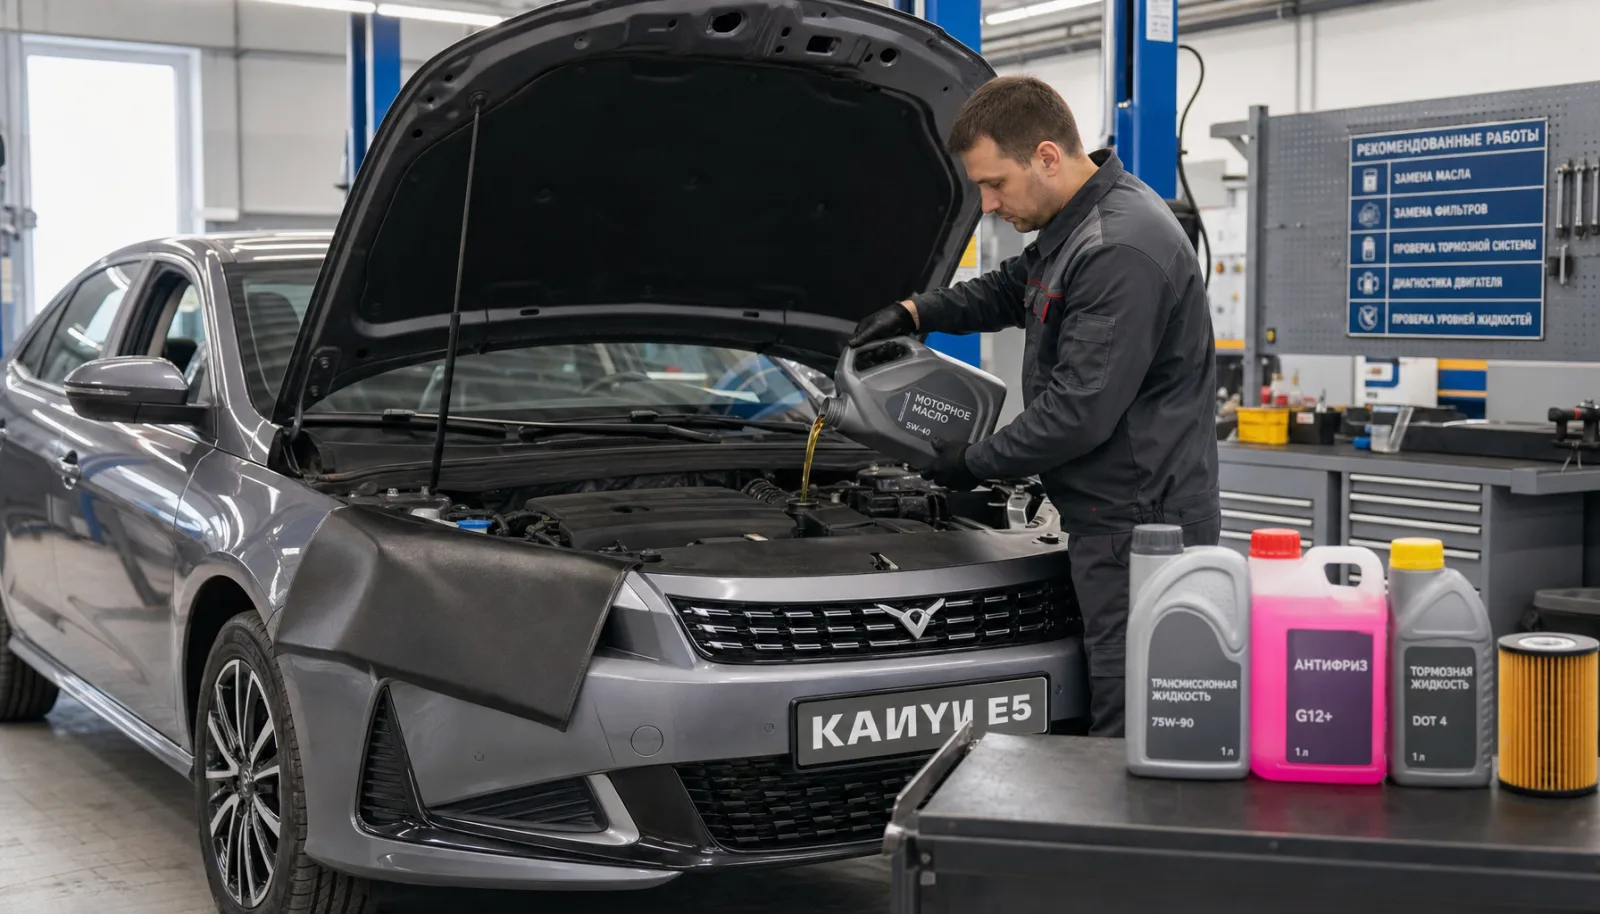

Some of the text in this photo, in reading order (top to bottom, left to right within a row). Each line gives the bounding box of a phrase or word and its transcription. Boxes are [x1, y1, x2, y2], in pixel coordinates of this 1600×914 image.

[1357, 128, 1539, 157] РЕКОМЕНДОВАННЫЕ РАБОТЫ
[1394, 168, 1471, 184] ЗАМЕНА МАСЛА
[1394, 203, 1488, 219] ЗАМЕНА ФИЛЬТРОВ
[1393, 238, 1536, 254] ПРОВЕРКА ТОРМОЗНОЙ СИСТЕМЫ
[1392, 276, 1502, 290] ДИАГНОСТИКА ДВИГАТЕЛЯ
[1392, 312, 1532, 327] ПРОВЕРКА УРОВНЕЙ ЖИДКОСТЕЙ
[912, 404, 949, 423] МАСЛО
[915, 393, 972, 421] МОТОРНОЕ
[905, 421, 931, 436] 5W-40
[1294, 659, 1368, 672] АНТИФРИЗ
[1410, 666, 1473, 677] ТОРМОЗНАЯ
[1151, 678, 1238, 690] ТРАНСМИССИОННАЯ
[1410, 679, 1470, 692] ЖИДКОСТЬ
[1151, 691, 1212, 703] ЖИДКОСТЬ
[1295, 708, 1333, 723] G12+
[1412, 715, 1447, 727] DOT 4
[1151, 717, 1194, 728] 75W-90
[1221, 746, 1234, 757] 1 л
[1295, 747, 1309, 757] 1 л
[1412, 752, 1426, 762] 1 л
